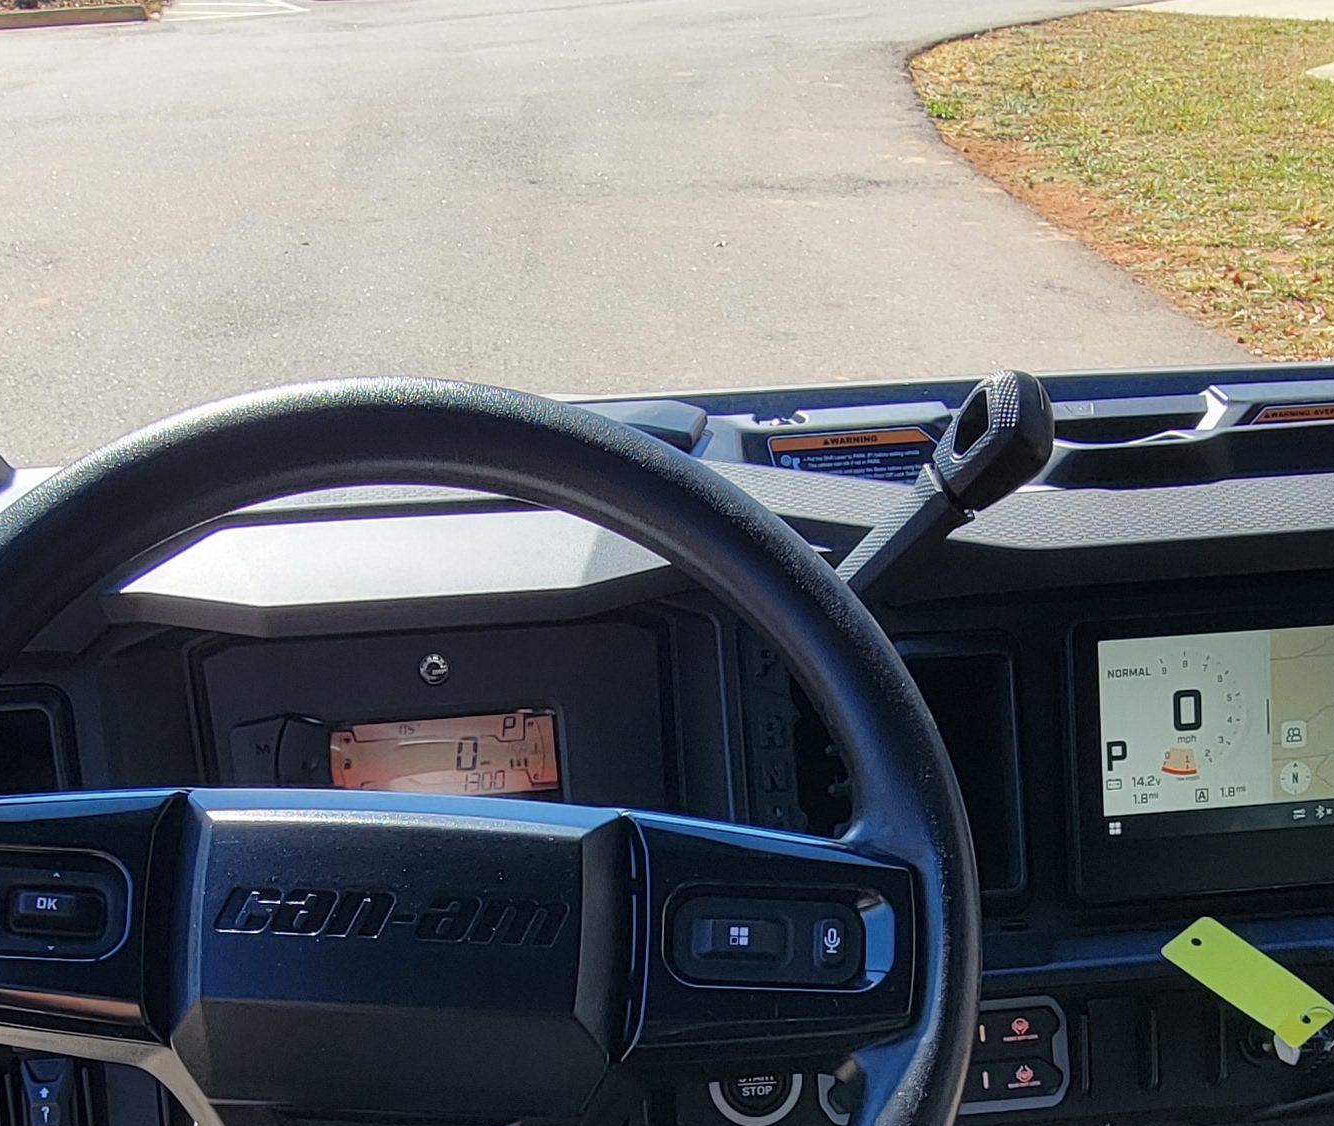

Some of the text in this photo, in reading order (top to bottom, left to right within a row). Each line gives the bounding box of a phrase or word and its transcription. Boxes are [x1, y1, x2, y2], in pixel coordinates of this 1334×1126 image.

[830, 435, 878, 446] WARNING
[1107, 666, 1151, 679] NORMAL
[1202, 664, 1208, 672] 7
[1173, 689, 1202, 731] 0
[1226, 716, 1233, 724] 4
[502, 716, 516, 738] P
[1177, 735, 1197, 745] mph
[1218, 736, 1224, 744] 3
[457, 736, 478, 771] 0
[1106, 740, 1127, 772] P
[1204, 749, 1211, 757] 2
[1291, 770, 1300, 785] N
[1198, 790, 1207, 801] A
[36, 897, 58, 911] OK
[215, 885, 570, 948] can-am
[742, 1085, 773, 1097] STOP
